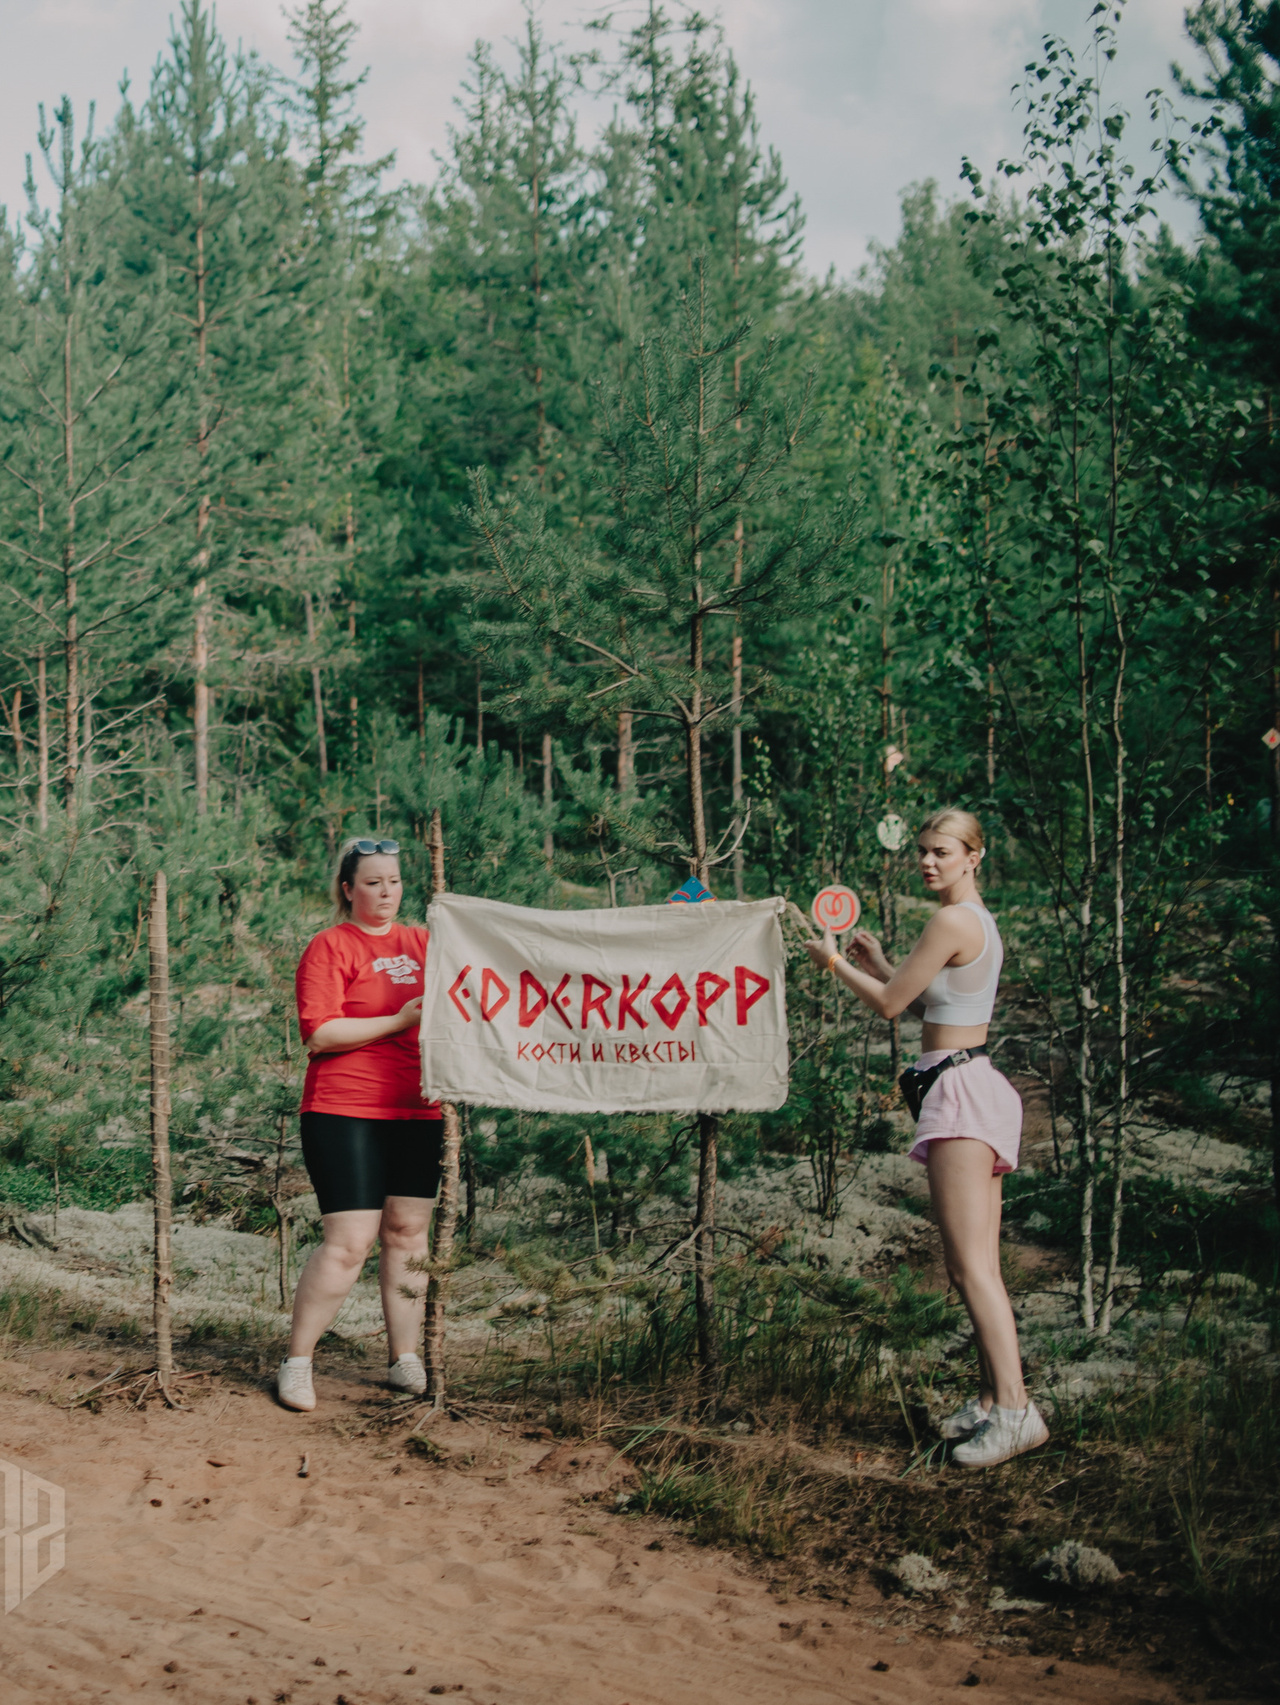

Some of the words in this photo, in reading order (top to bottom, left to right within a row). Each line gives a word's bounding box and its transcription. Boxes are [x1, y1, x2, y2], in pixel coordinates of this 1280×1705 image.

[447, 965, 770, 1031] EDDERKOPP
[517, 1040, 581, 1064] КОСТИ
[592, 1042, 604, 1063] И
[615, 1040, 696, 1063] КВЕСТЫ
